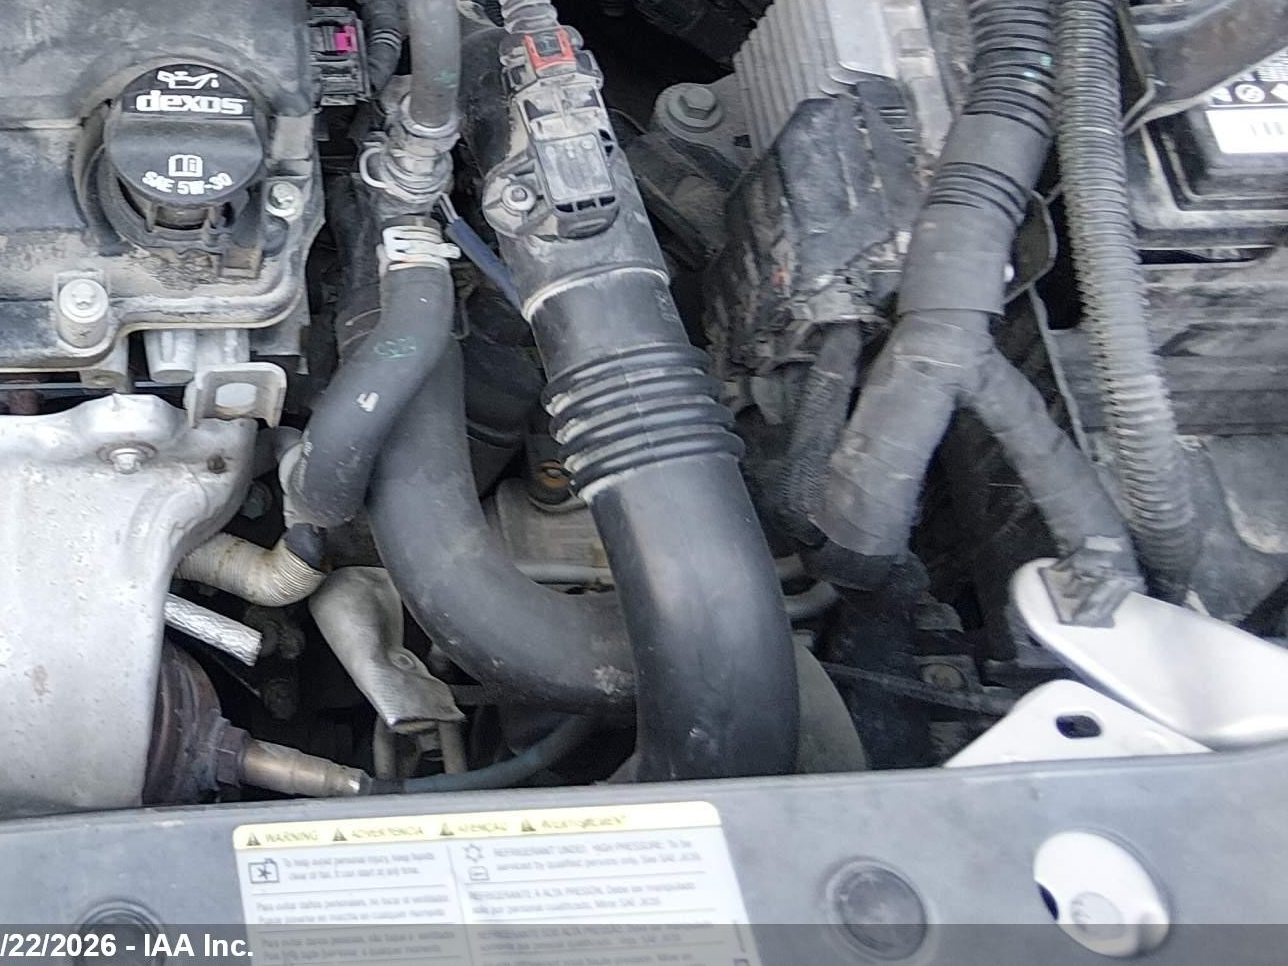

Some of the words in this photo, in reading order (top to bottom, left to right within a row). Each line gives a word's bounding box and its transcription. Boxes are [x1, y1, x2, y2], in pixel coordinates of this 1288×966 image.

[136, 89, 249, 115] dexos
[142, 171, 176, 193] SAE
[177, 172, 233, 195] 5W-30
